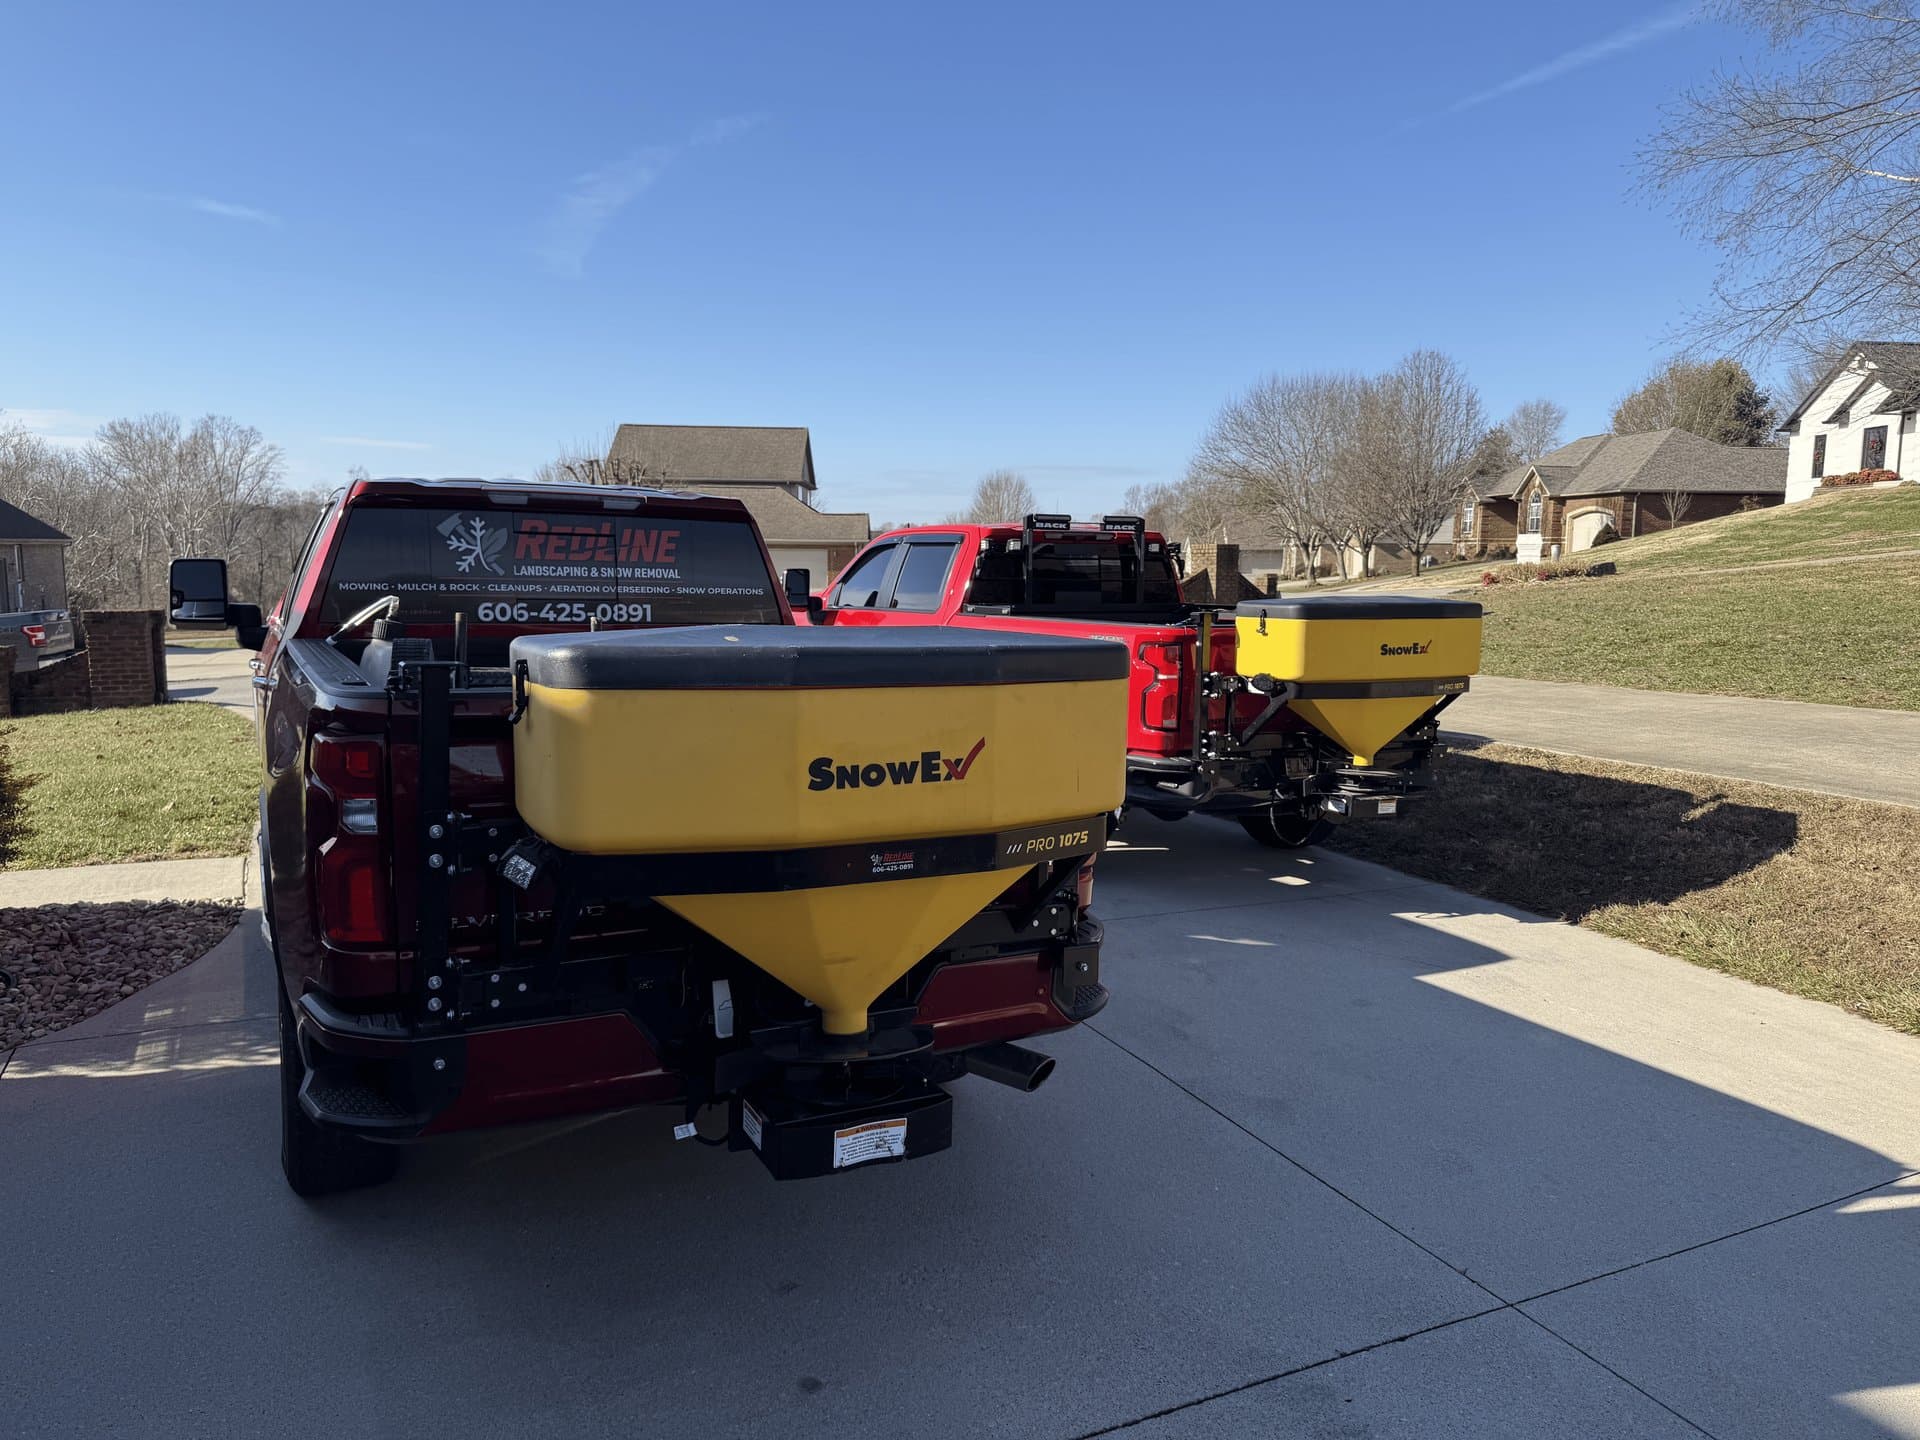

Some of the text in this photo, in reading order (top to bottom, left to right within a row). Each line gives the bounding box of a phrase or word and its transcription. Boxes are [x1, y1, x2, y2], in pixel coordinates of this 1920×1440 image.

[513, 565, 681, 579] LANDSCAPING & SNOW REMOVAL
[339, 582, 764, 596] MOWING MULCH & ROCK CLEANUPS AERATION OVERSEEDING SNOW OPERATIONS
[477, 602, 652, 623] 606-425-0891
[1026, 830, 1089, 854] PRO 1075
